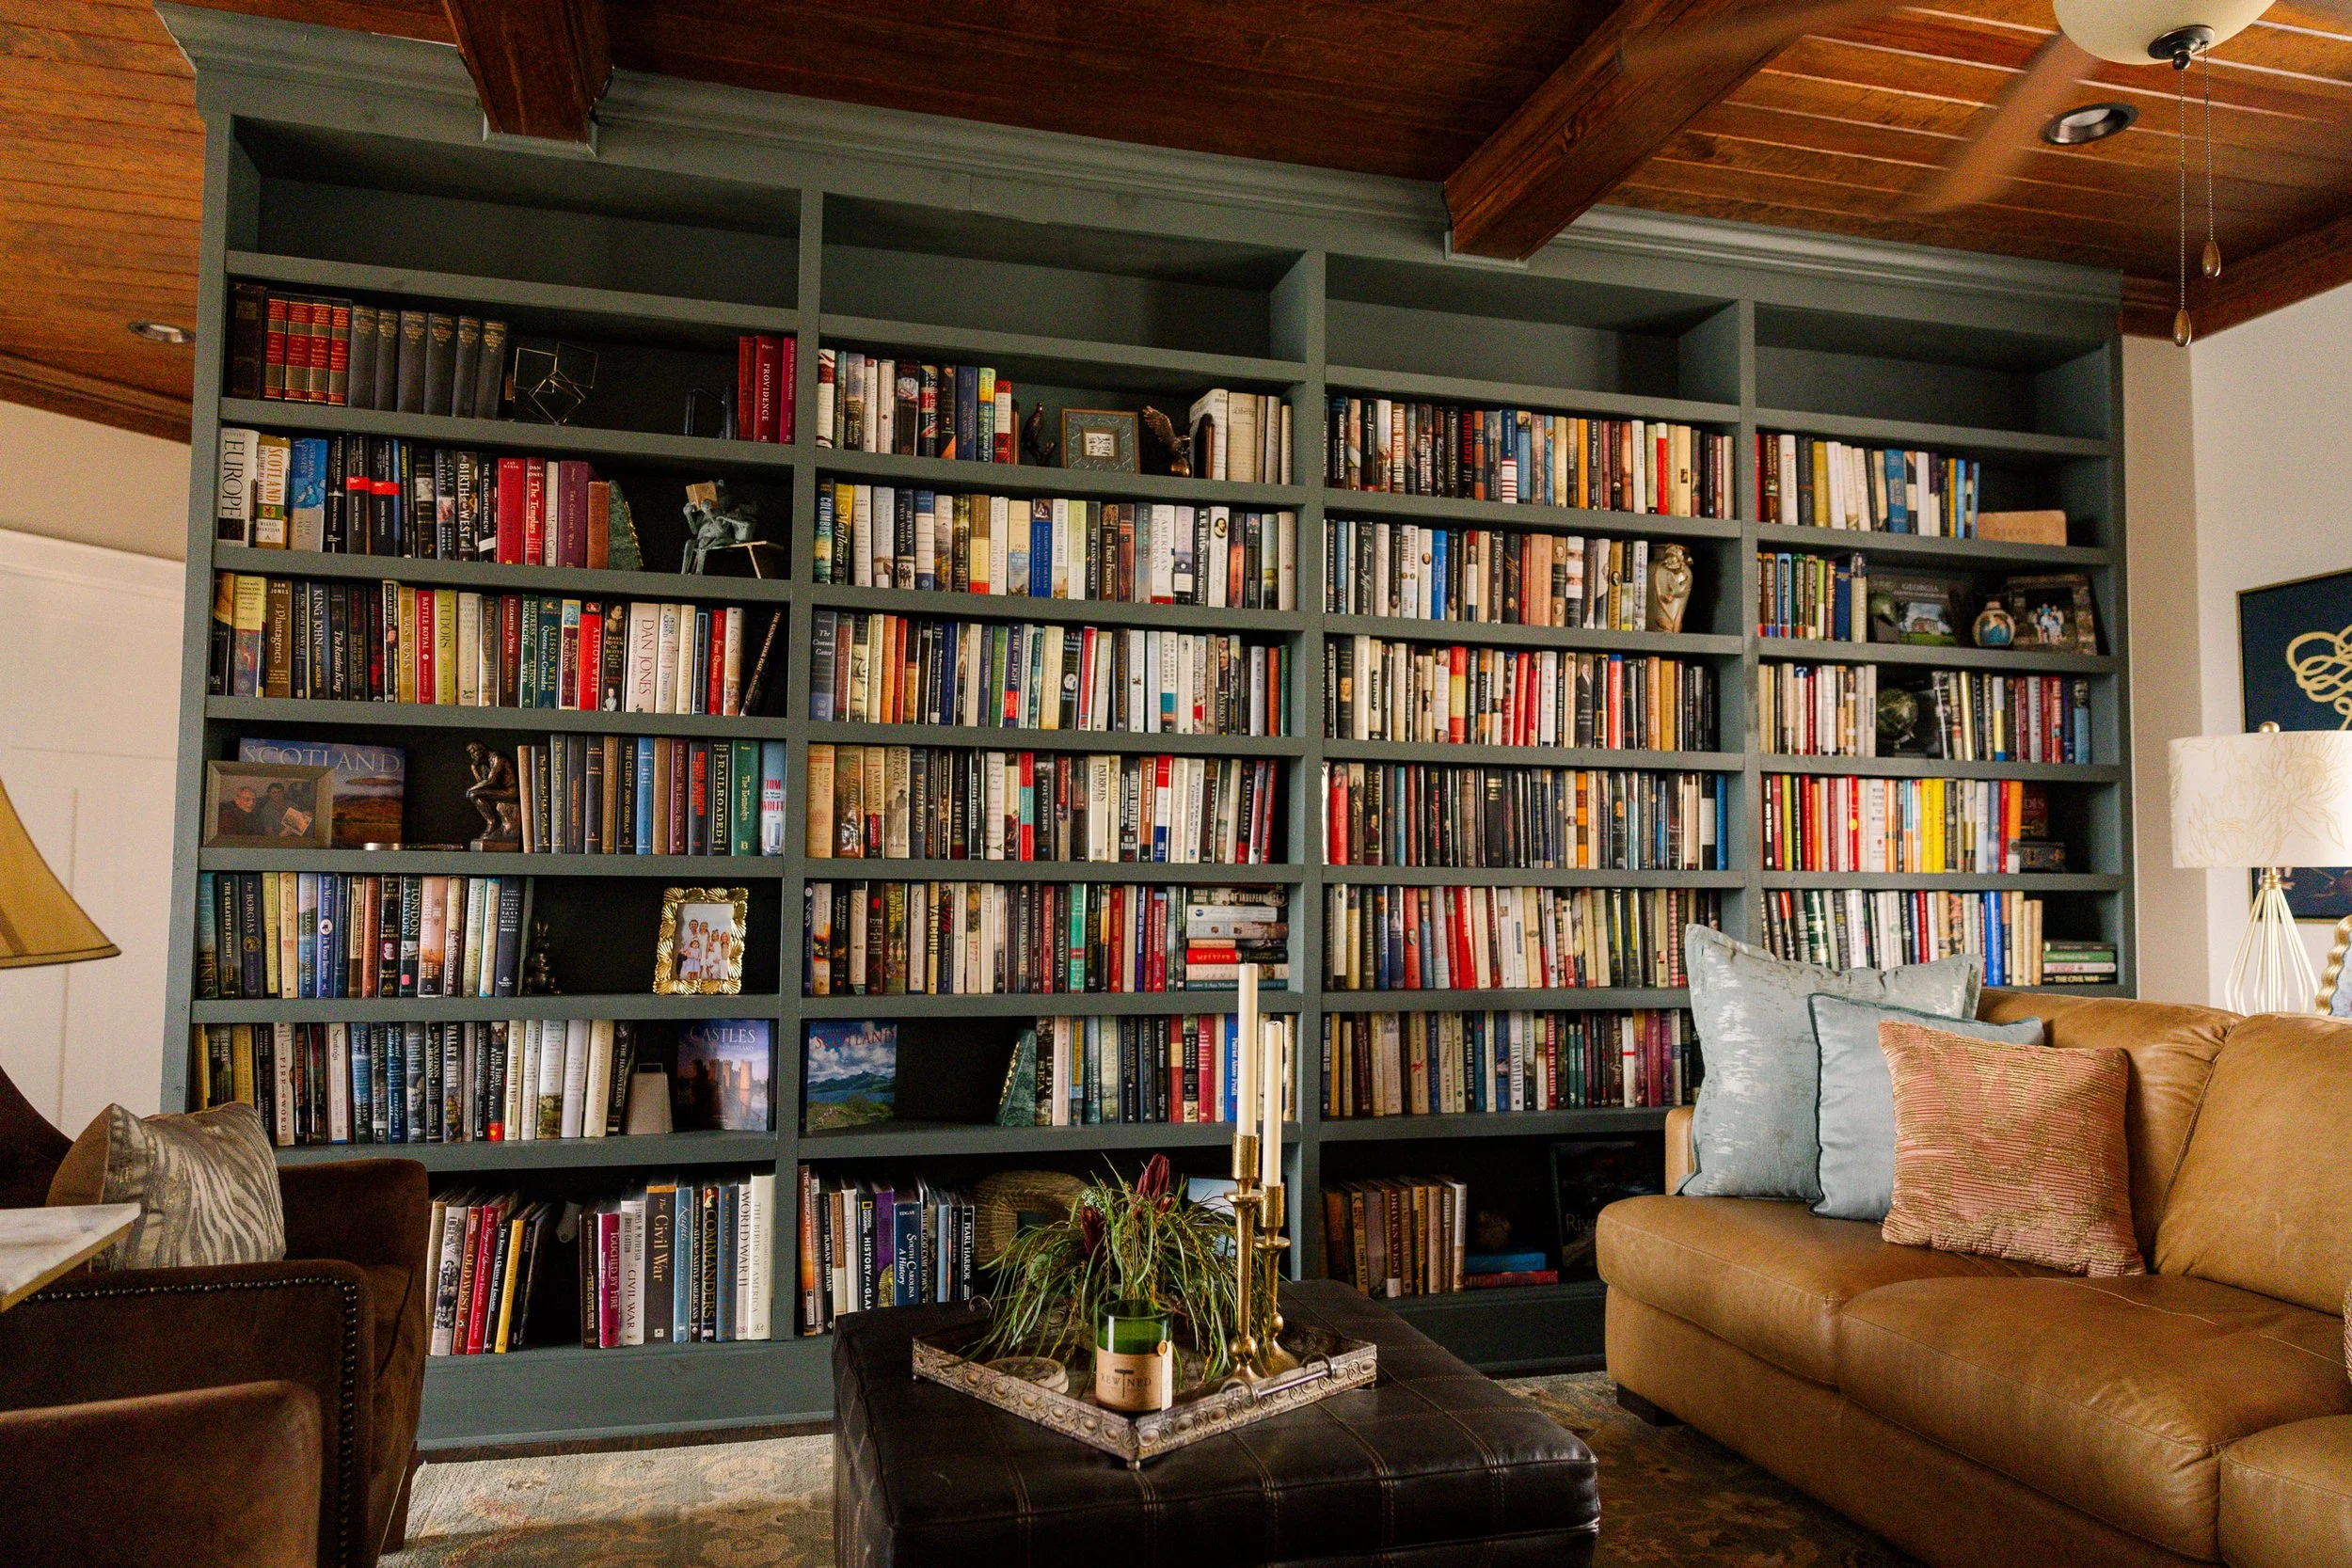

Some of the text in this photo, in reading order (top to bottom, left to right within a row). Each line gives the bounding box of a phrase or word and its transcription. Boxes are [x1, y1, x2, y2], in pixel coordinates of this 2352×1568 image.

[1393, 409, 1403, 483] YOUNG WASHINGTON
[1463, 414, 1471, 464] PATRIARCH
[222, 440, 244, 517] EUROPE
[266, 448, 282, 501] SCOTLAND
[1784, 452, 1793, 499] Protestants
[528, 481, 540, 534] The Templars
[819, 498, 831, 535] COLUMBUS
[834, 504, 849, 564] Mayflower
[1106, 546, 1115, 562] FIRST
[1492, 534, 1503, 574] Jefferson
[1105, 564, 1114, 594] FRONTIER
[1360, 539, 1372, 608] Thomas Jefferson
[1901, 582, 1940, 593] GEORGIA
[333, 631, 343, 692] The Restless Kings
[638, 619, 654, 694] DAN JONES
[712, 640, 723, 678] Four Queens
[1219, 690, 1229, 727] PATRIOTS
[716, 760, 724, 837] RAILROADED
[740, 790, 749, 820] Kennedys
[915, 773, 924, 832] WHIRLWIND
[246, 894, 255, 933] BORGIAS
[402, 896, 410, 936] HISTORY
[410, 888, 421, 936] LONDON
[929, 905, 938, 955] VALCOUR
[943, 907, 953, 932] 1776
[969, 940, 977, 962] 1777
[2084, 974, 2100, 984] WAR
[332, 1030, 342, 1061] Saratoga
[689, 1025, 756, 1044] CASTLES
[814, 1029, 896, 1050] SCOTLAND
[446, 1025, 457, 1087] VALLEY FORGE
[1512, 1042, 1521, 1092] JACKSONLAND
[615, 1059, 626, 1107] HANOVERIANS
[524, 1227, 532, 1253] Scotland
[654, 1214, 669, 1249] Civil
[739, 1191, 751, 1287] WORLD WAR II
[463, 1254, 474, 1278] OLD
[494, 1260, 502, 1280] QUEENS
[609, 1232, 619, 1309] TOUCHED BY FIRE
[653, 1253, 668, 1282] War
[703, 1210, 716, 1319] COMMANDERS
[752, 1202, 761, 1313] THE BIRDS OF AMERICA
[897, 1257, 906, 1285] History
[907, 1233, 917, 1298] SOUTH CAROLINA
[460, 1280, 471, 1314] WEST
[490, 1289, 499, 1312] ENGLAND
[627, 1269, 636, 1329] CIVIL WAR
